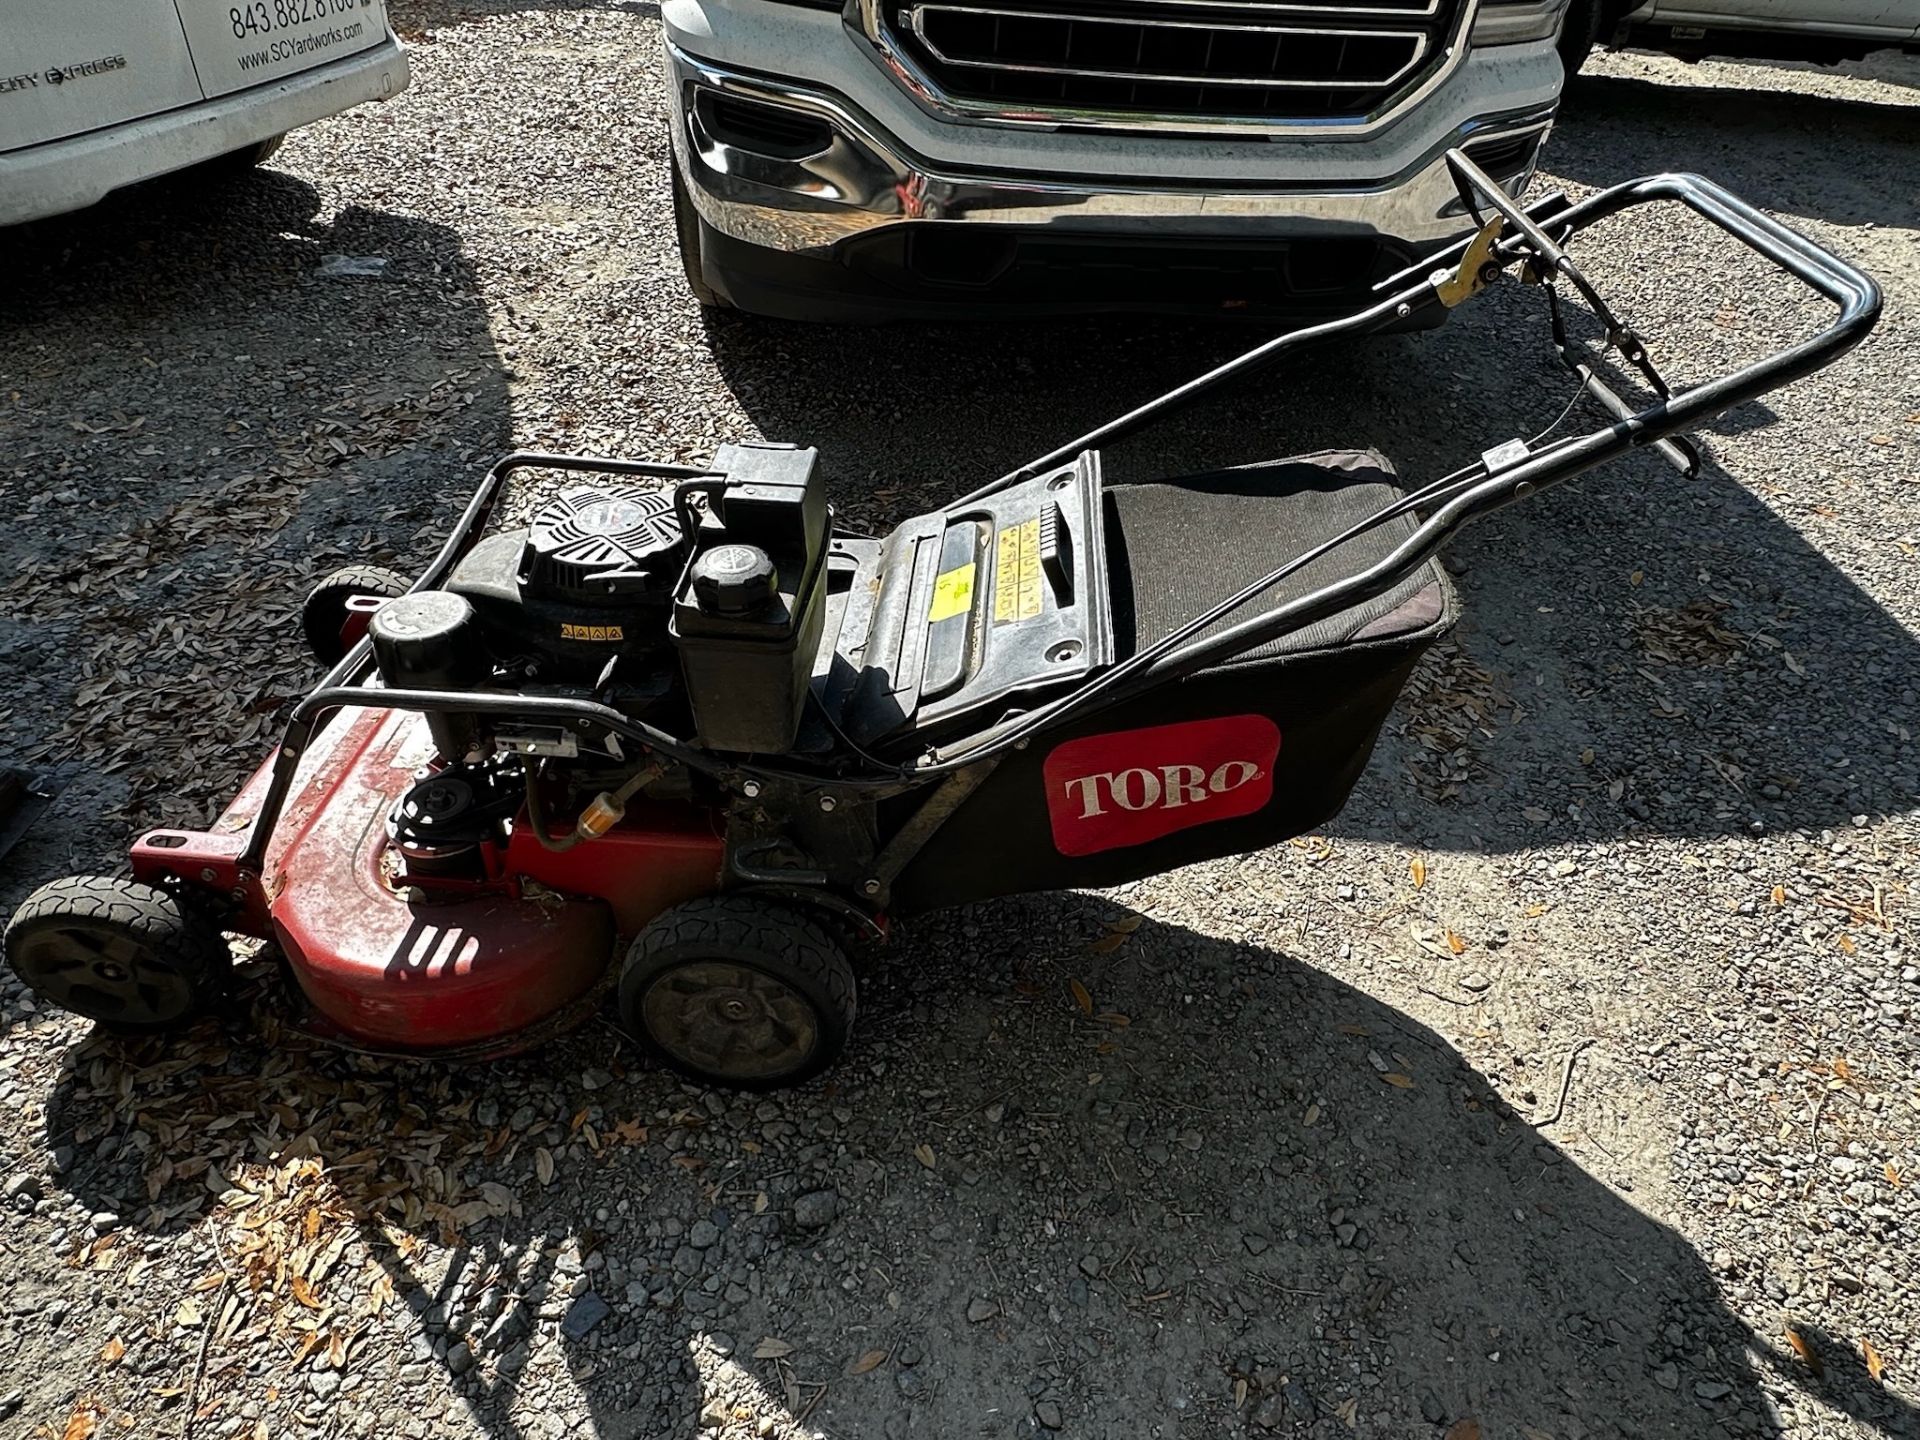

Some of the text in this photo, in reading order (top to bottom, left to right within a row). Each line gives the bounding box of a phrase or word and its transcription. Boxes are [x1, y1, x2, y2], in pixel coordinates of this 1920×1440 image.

[45, 54, 127, 85] EXPRESS
[238, 22, 363, 71] www.SCYardworks.com
[1065, 761, 1258, 819] TORO
